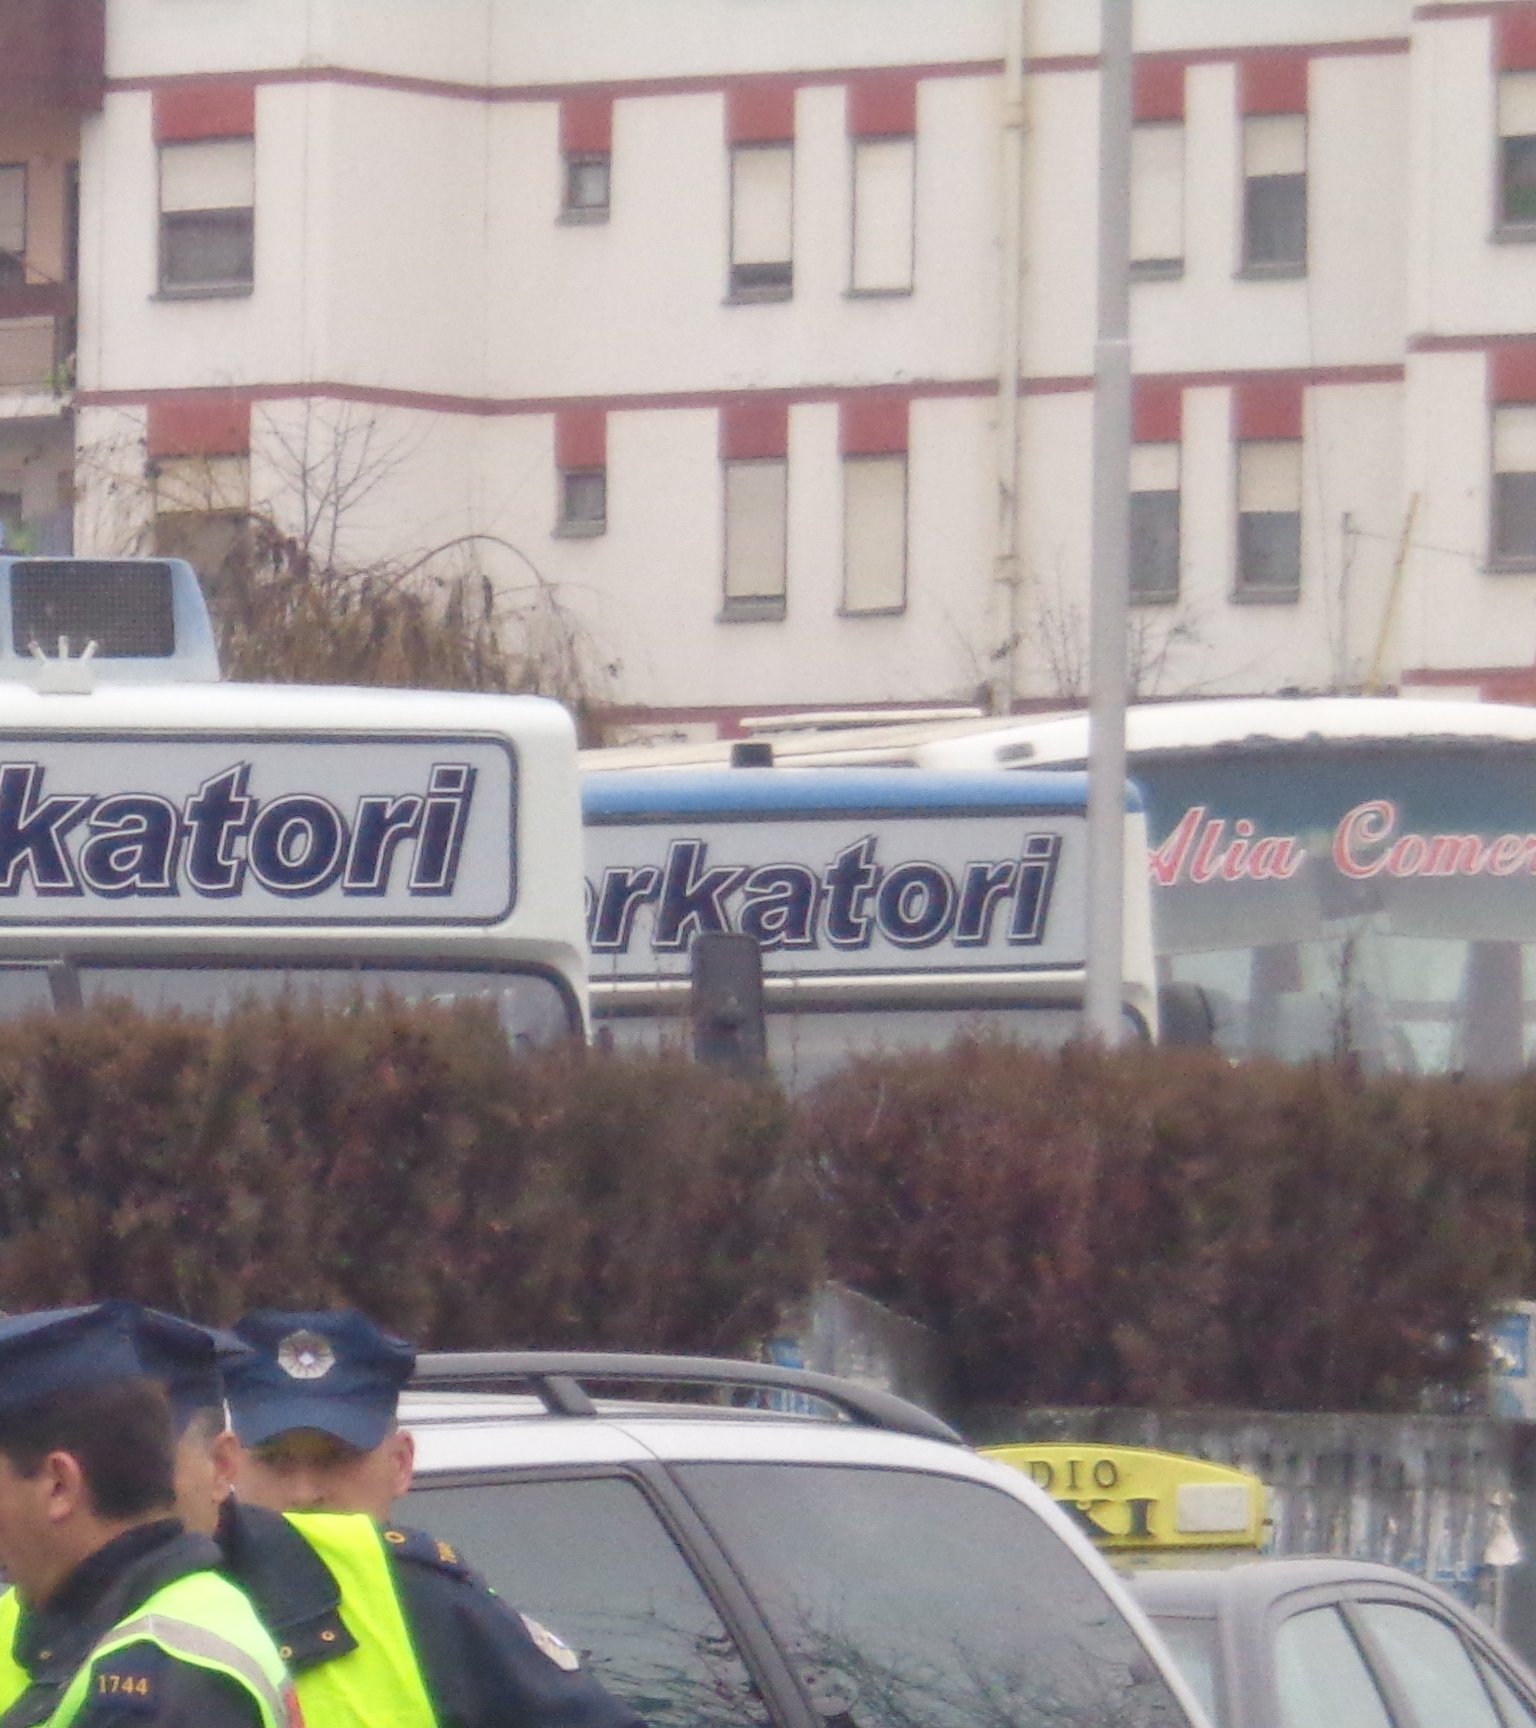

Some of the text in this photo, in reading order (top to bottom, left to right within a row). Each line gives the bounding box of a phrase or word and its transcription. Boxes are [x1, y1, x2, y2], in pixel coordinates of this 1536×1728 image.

[584, 832, 1062, 951] rkatori
[1025, 1458, 1119, 1490] DIO
[97, 1672, 150, 1697] 1744
